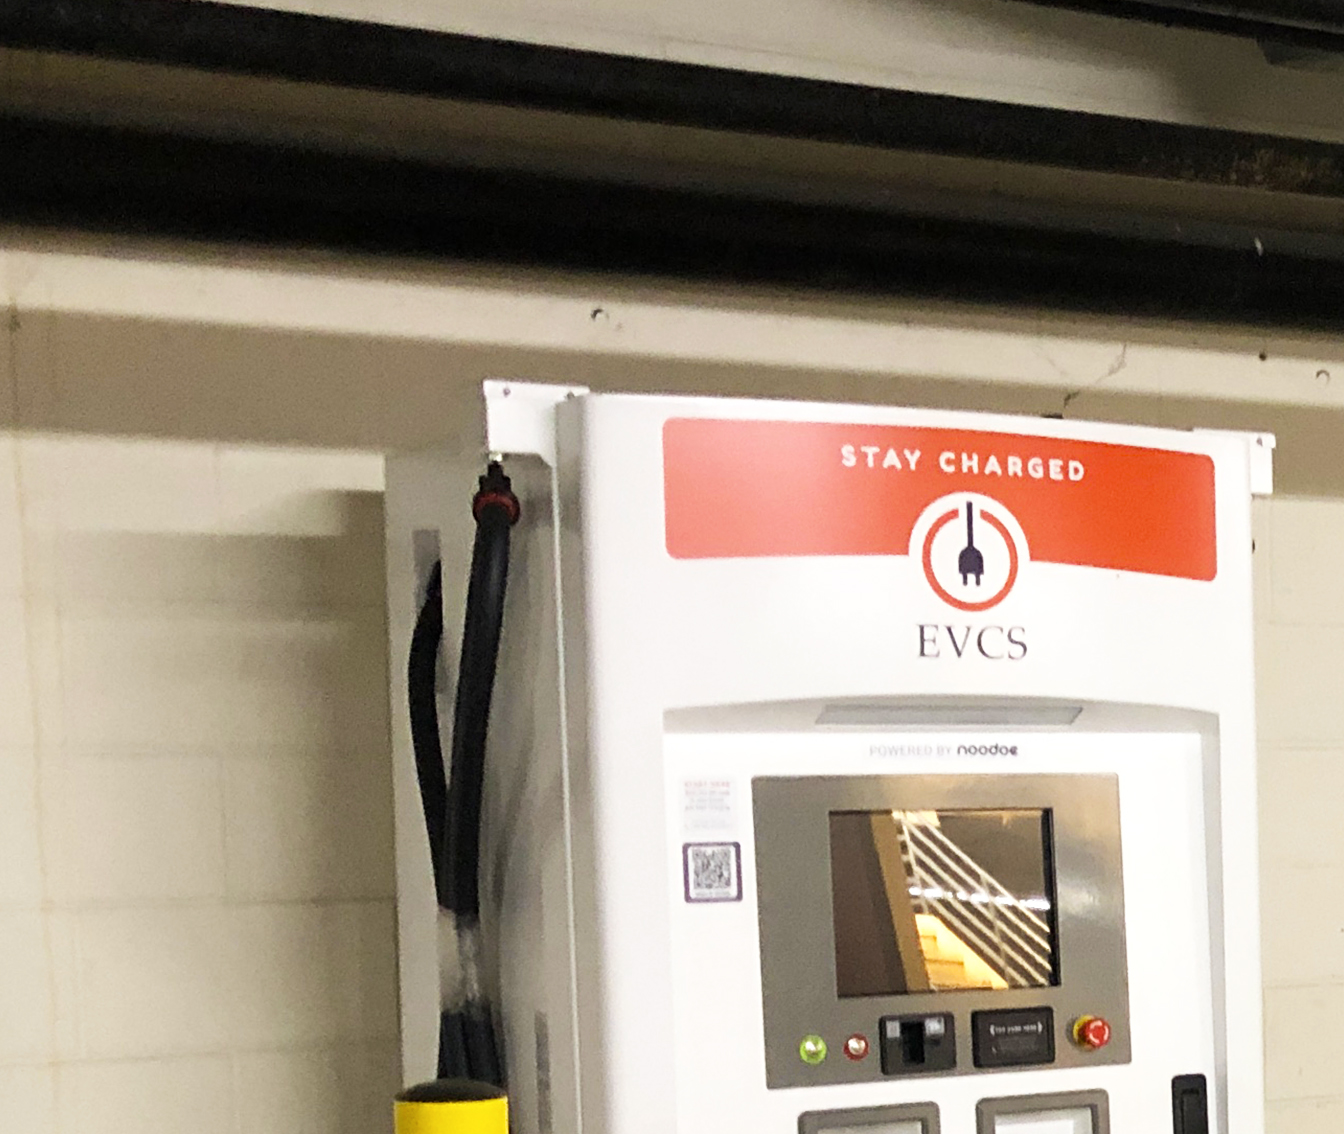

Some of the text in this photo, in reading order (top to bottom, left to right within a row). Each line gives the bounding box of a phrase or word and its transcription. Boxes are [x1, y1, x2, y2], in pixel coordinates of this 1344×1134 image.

[840, 443, 1086, 482] STAY CHARGED
[916, 622, 1029, 661] EVCS
[869, 743, 1019, 757] POWERED BY noodoe
